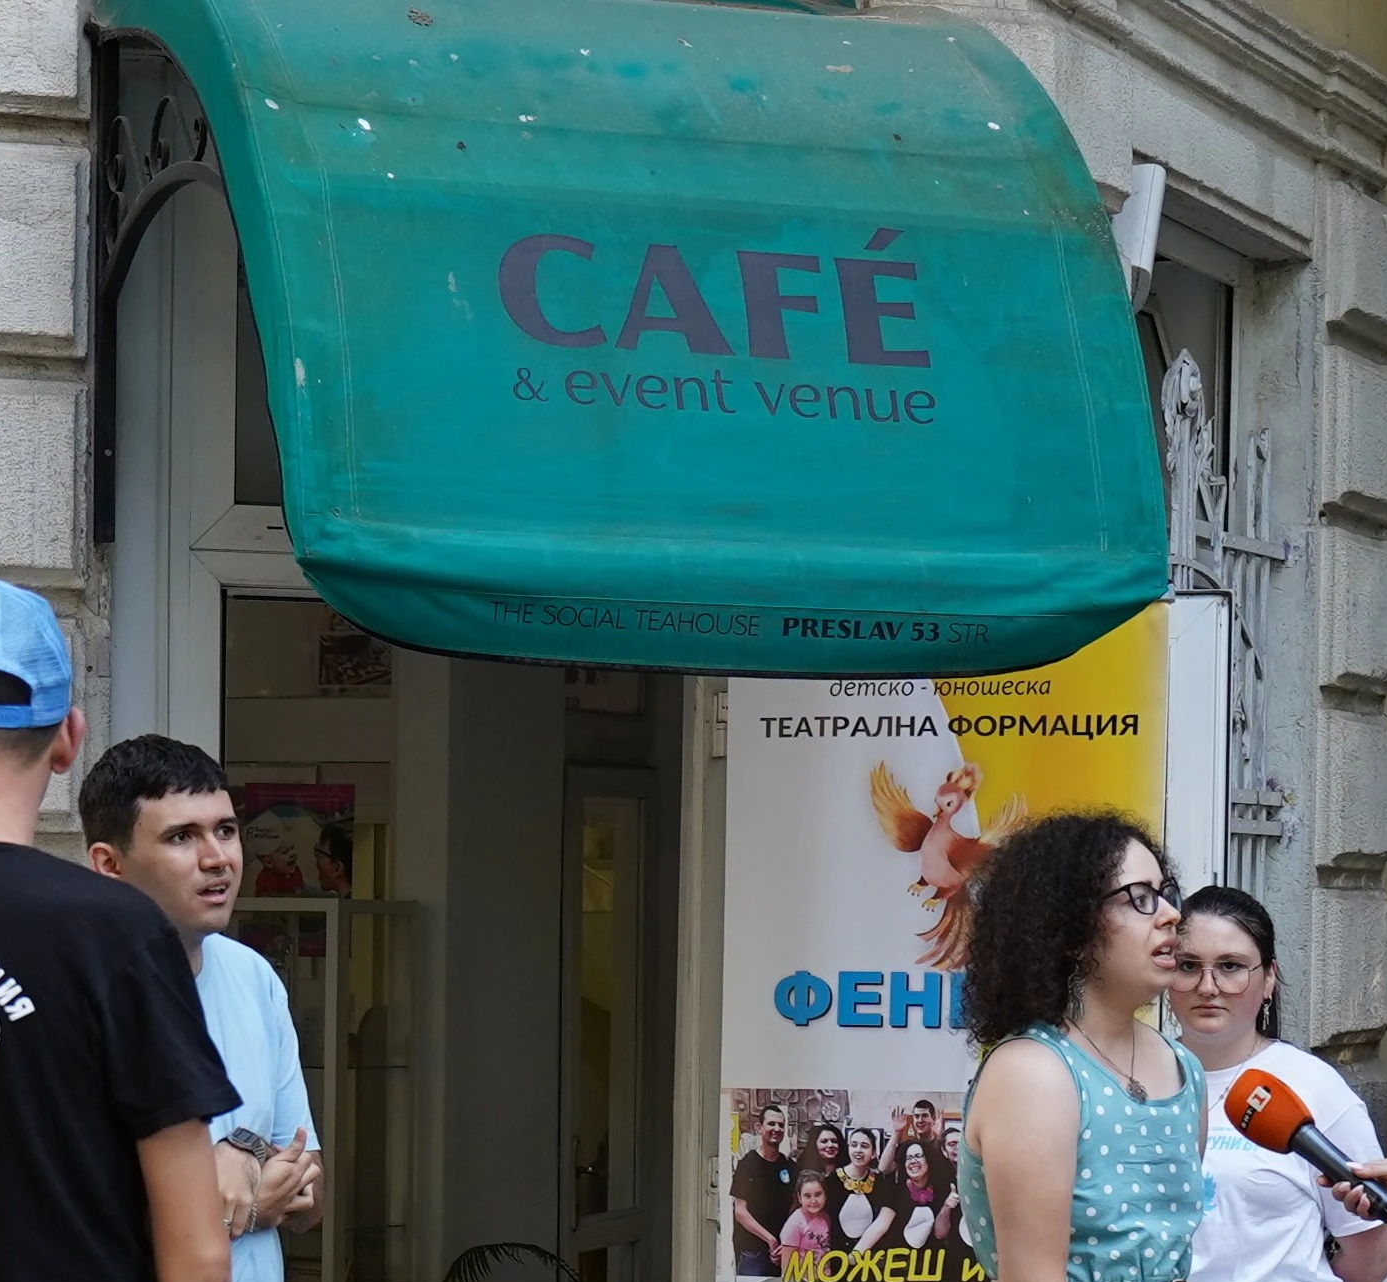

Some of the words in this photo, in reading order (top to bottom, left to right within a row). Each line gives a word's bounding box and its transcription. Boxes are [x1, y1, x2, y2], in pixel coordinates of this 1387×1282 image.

[498, 228, 931, 368] CAFÉ
[513, 367, 548, 402] &
[565, 369, 736, 415] event
[754, 381, 936, 425] venue
[491, 601, 533, 626] THE
[541, 604, 626, 631] SOCIAL
[635, 609, 760, 637] TEAHOUSE
[782, 617, 904, 642] PRESLAV
[910, 622, 940, 642] 53
[947, 622, 990, 644] STR
[830, 679, 914, 697] детско
[933, 679, 1051, 697] юношеска
[760, 715, 938, 738] ТЕАТРАЛНА
[948, 713, 1139, 742] ФОРМАЦИЯ
